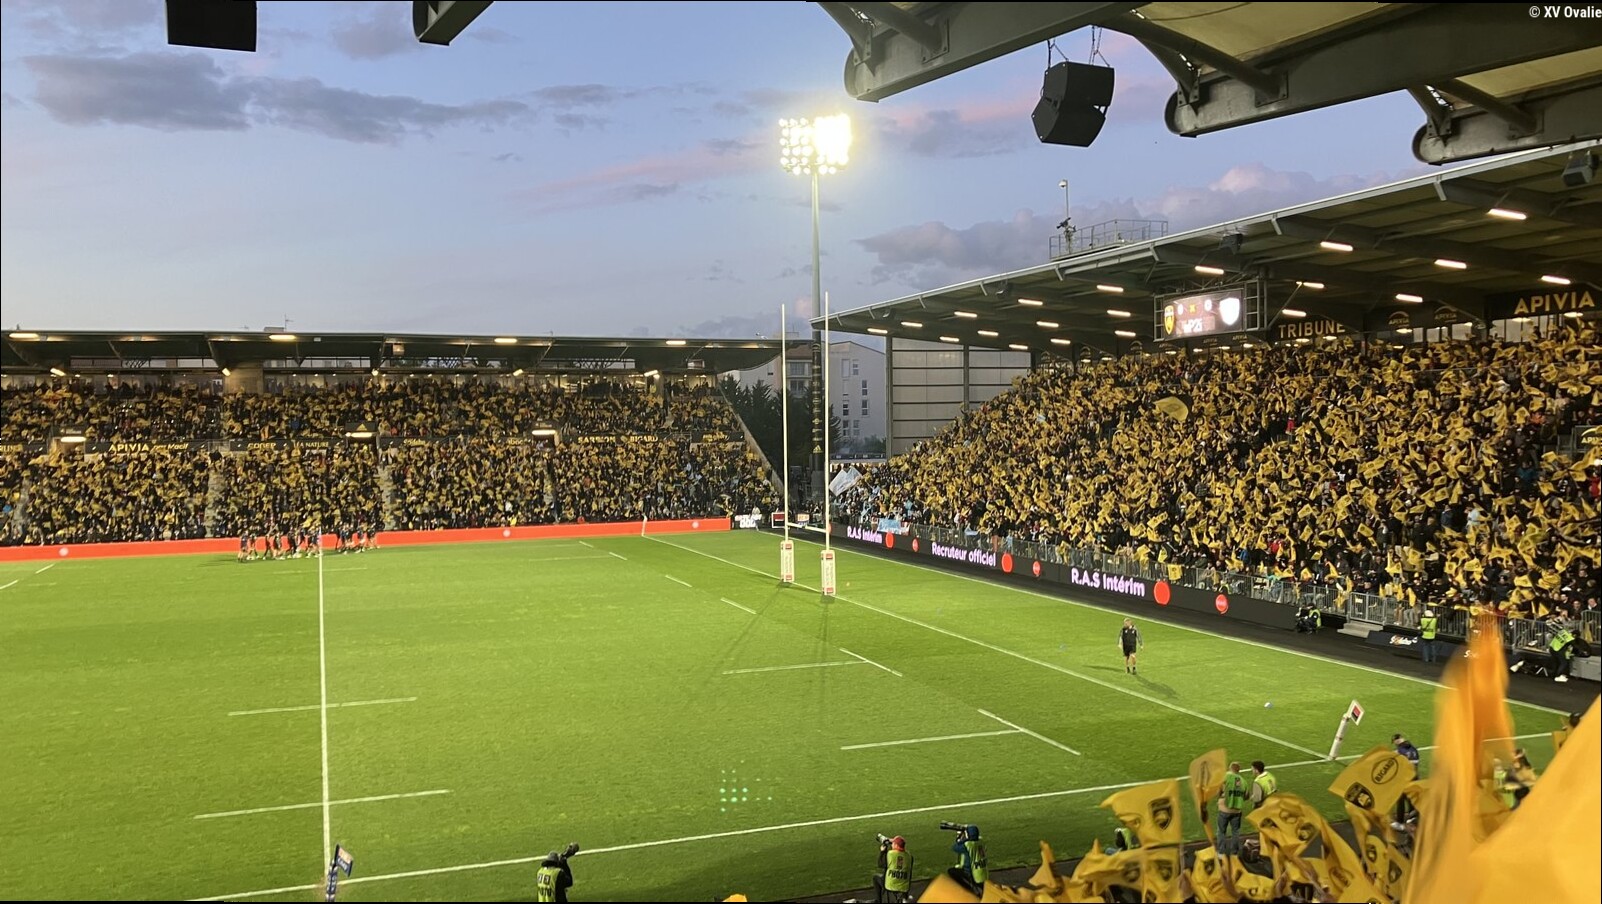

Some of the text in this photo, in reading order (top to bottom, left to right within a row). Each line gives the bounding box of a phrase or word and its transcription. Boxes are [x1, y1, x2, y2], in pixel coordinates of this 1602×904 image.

[1513, 290, 1596, 315] APIVIA
[1278, 319, 1347, 339] TRIBUNE
[108, 443, 150, 452] APIVIA
[846, 525, 862, 540] R.A.S
[931, 541, 967, 561] Recruteur
[968, 547, 997, 567] officiel
[1071, 567, 1146, 597] R.A.S Intérim
[887, 869, 909, 880] PHOTO
